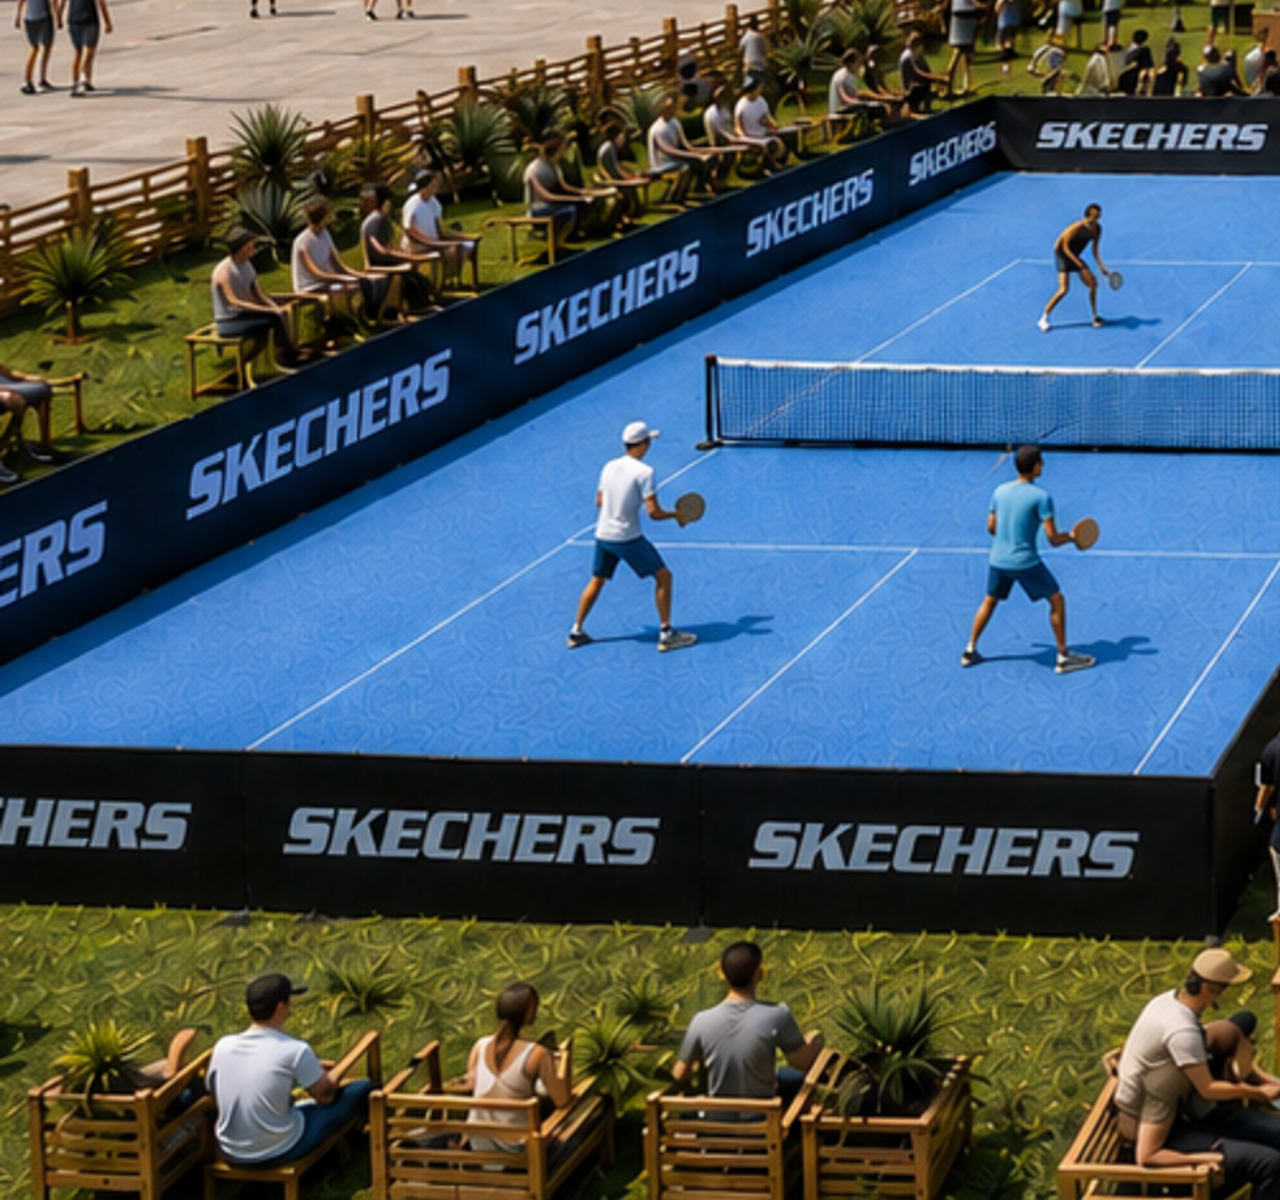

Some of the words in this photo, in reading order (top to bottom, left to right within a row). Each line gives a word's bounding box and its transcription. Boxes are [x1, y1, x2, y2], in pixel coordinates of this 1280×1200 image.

[1037, 123, 1268, 150] SKECHERS
[746, 168, 874, 257] SKECHERS
[514, 240, 700, 365] SKECHERS
[186, 348, 452, 521] SKECHERS
[0, 798, 191, 849] HERS
[284, 808, 659, 864] SKECHERS
[749, 822, 1138, 877] SKECHERS
